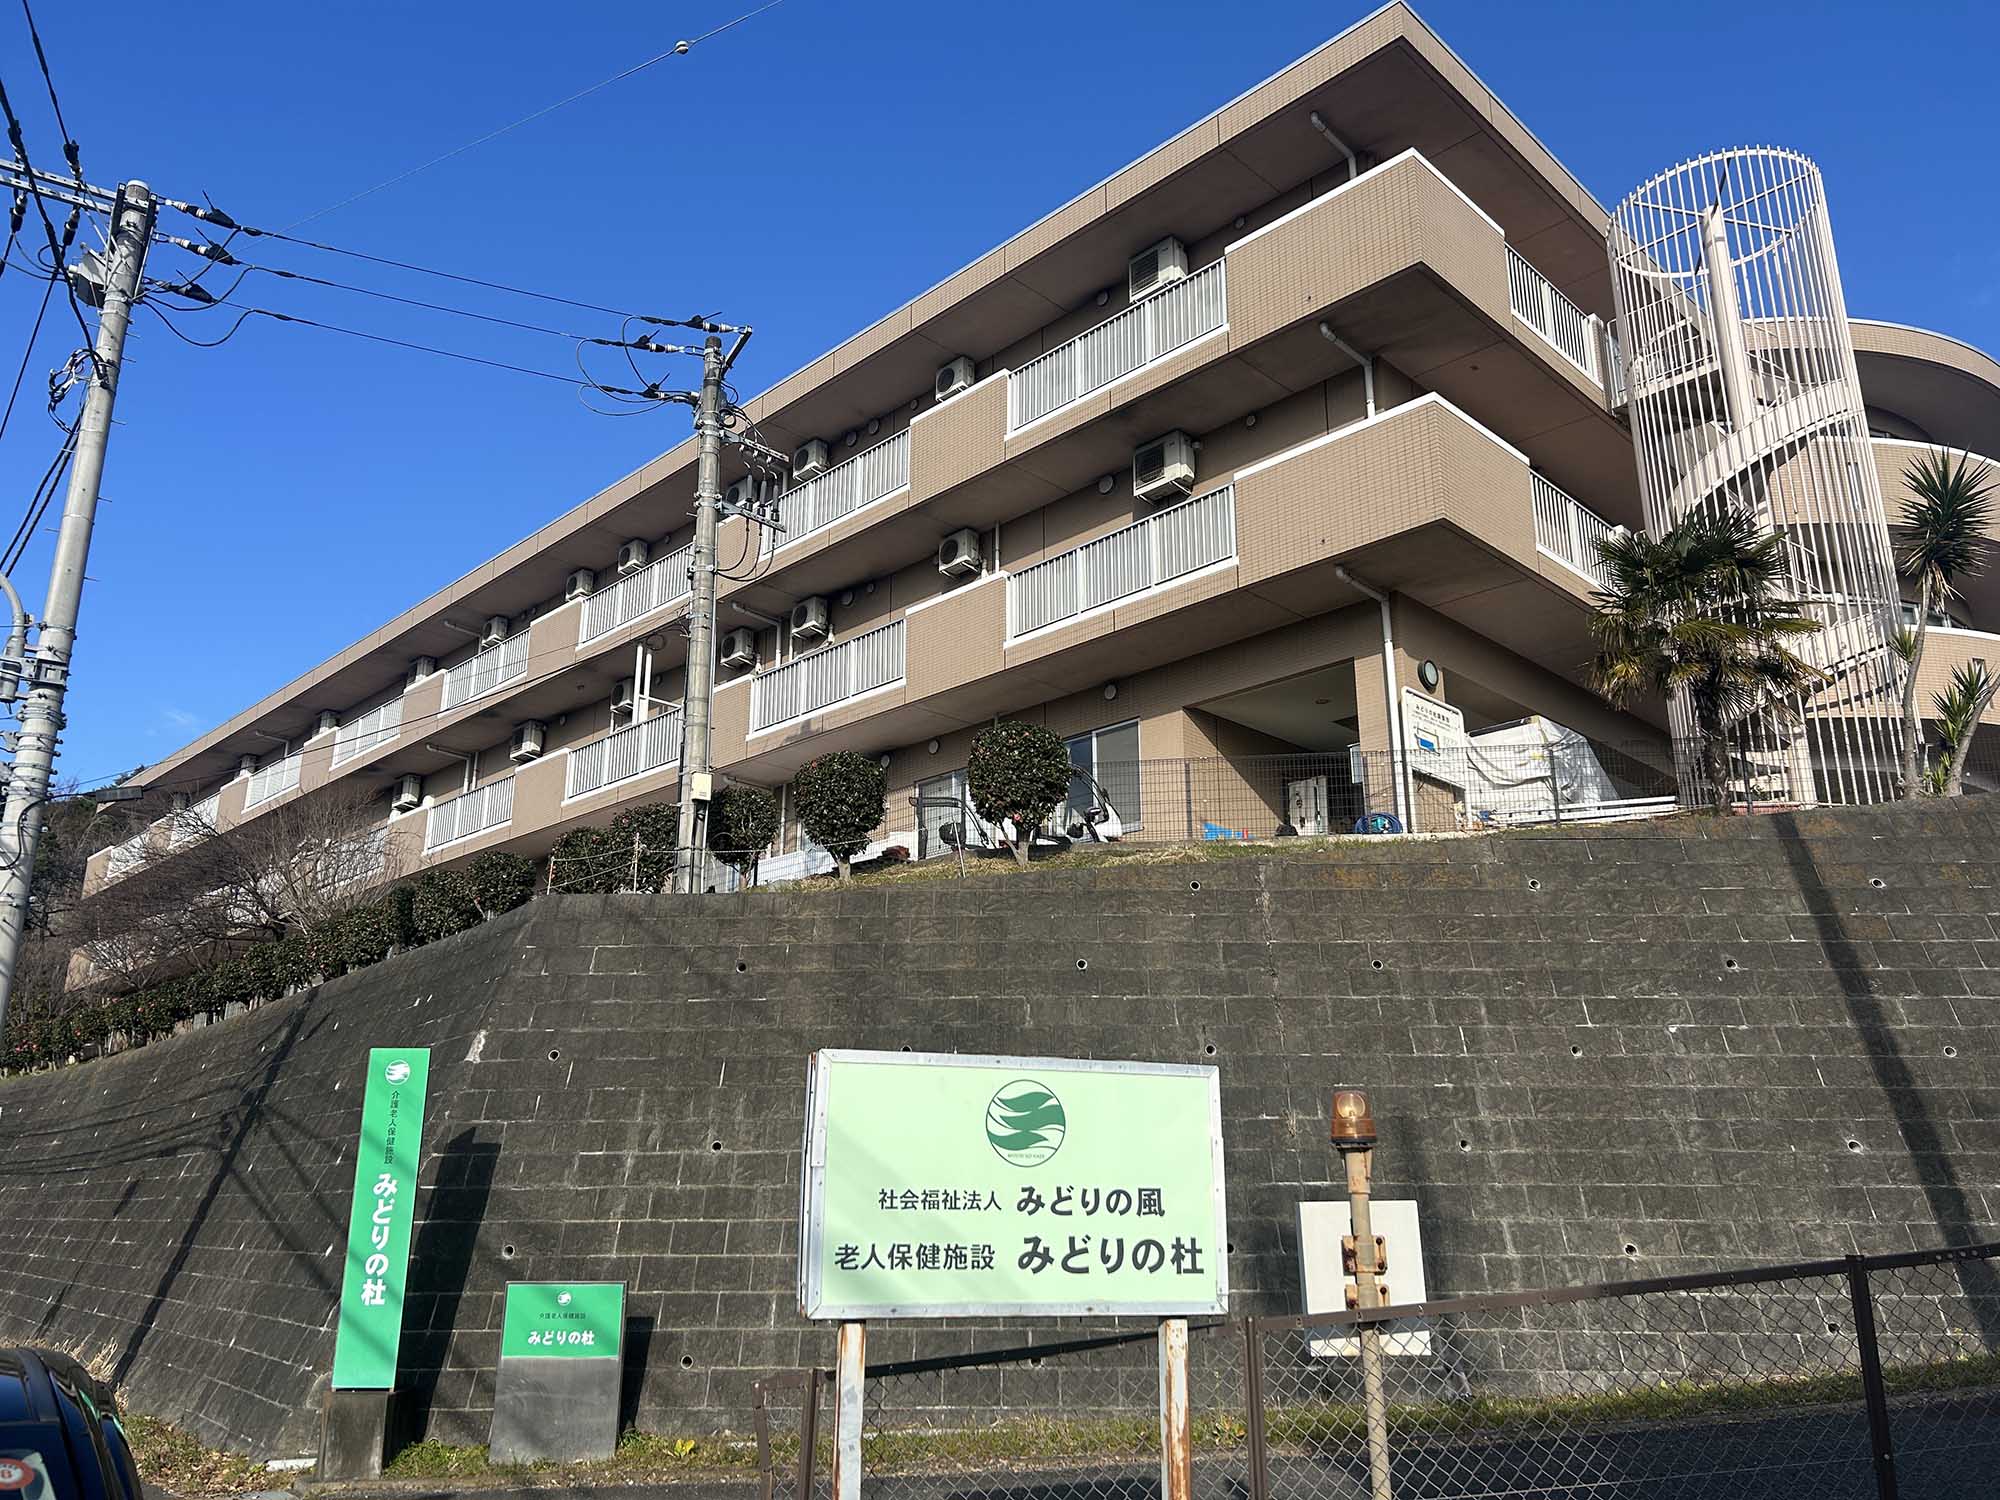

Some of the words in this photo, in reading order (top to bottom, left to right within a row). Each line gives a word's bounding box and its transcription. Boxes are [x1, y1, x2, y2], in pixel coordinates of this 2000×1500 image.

[878, 1188, 1002, 1211] 社会福祉法人
[1016, 1185, 1166, 1217] みどりの風
[361, 1173, 398, 1306] みどりの杜
[834, 1243, 996, 1271] 老人保健施設
[1017, 1234, 1205, 1275] みどりの杜
[527, 1330, 595, 1346] みどりの杜
